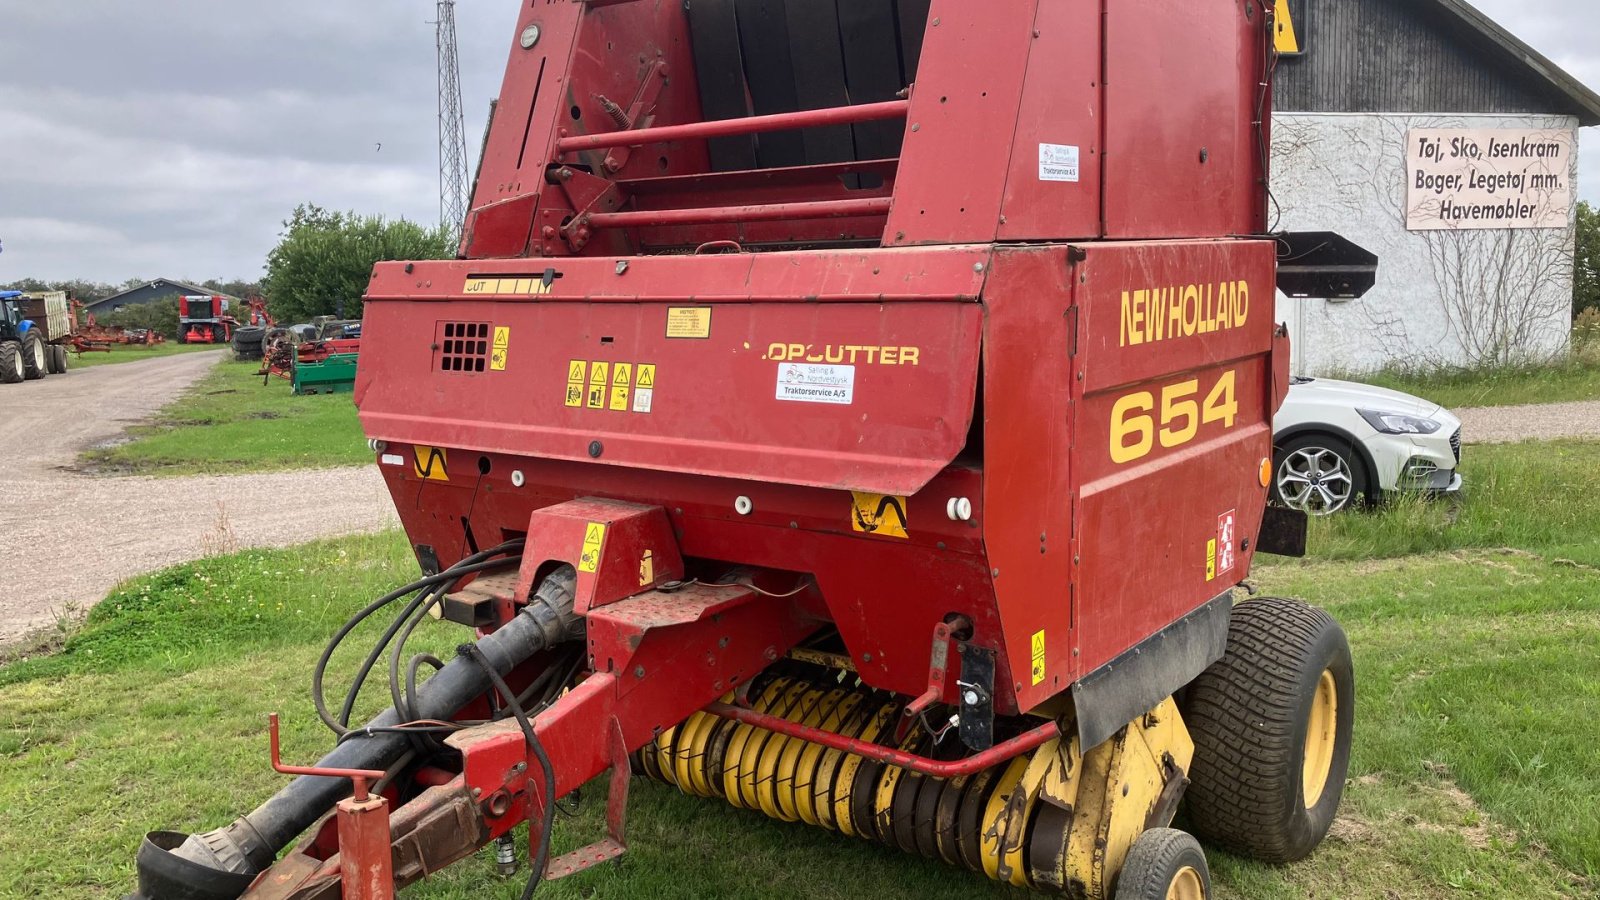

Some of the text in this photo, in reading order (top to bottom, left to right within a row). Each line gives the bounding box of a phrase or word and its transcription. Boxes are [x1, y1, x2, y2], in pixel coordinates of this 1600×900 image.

[1418, 136, 1560, 163] Tøj, Sko, Isenkram
[1415, 168, 1562, 194] Bøger, Legetøj mm.
[1439, 198, 1536, 220] Havemøbler
[1119, 280, 1249, 347] NEW HOLLAND
[744, 341, 921, 366] OPCUTTER
[784, 386, 846, 398] Traktorservice A/S
[1109, 369, 1238, 464] 654
